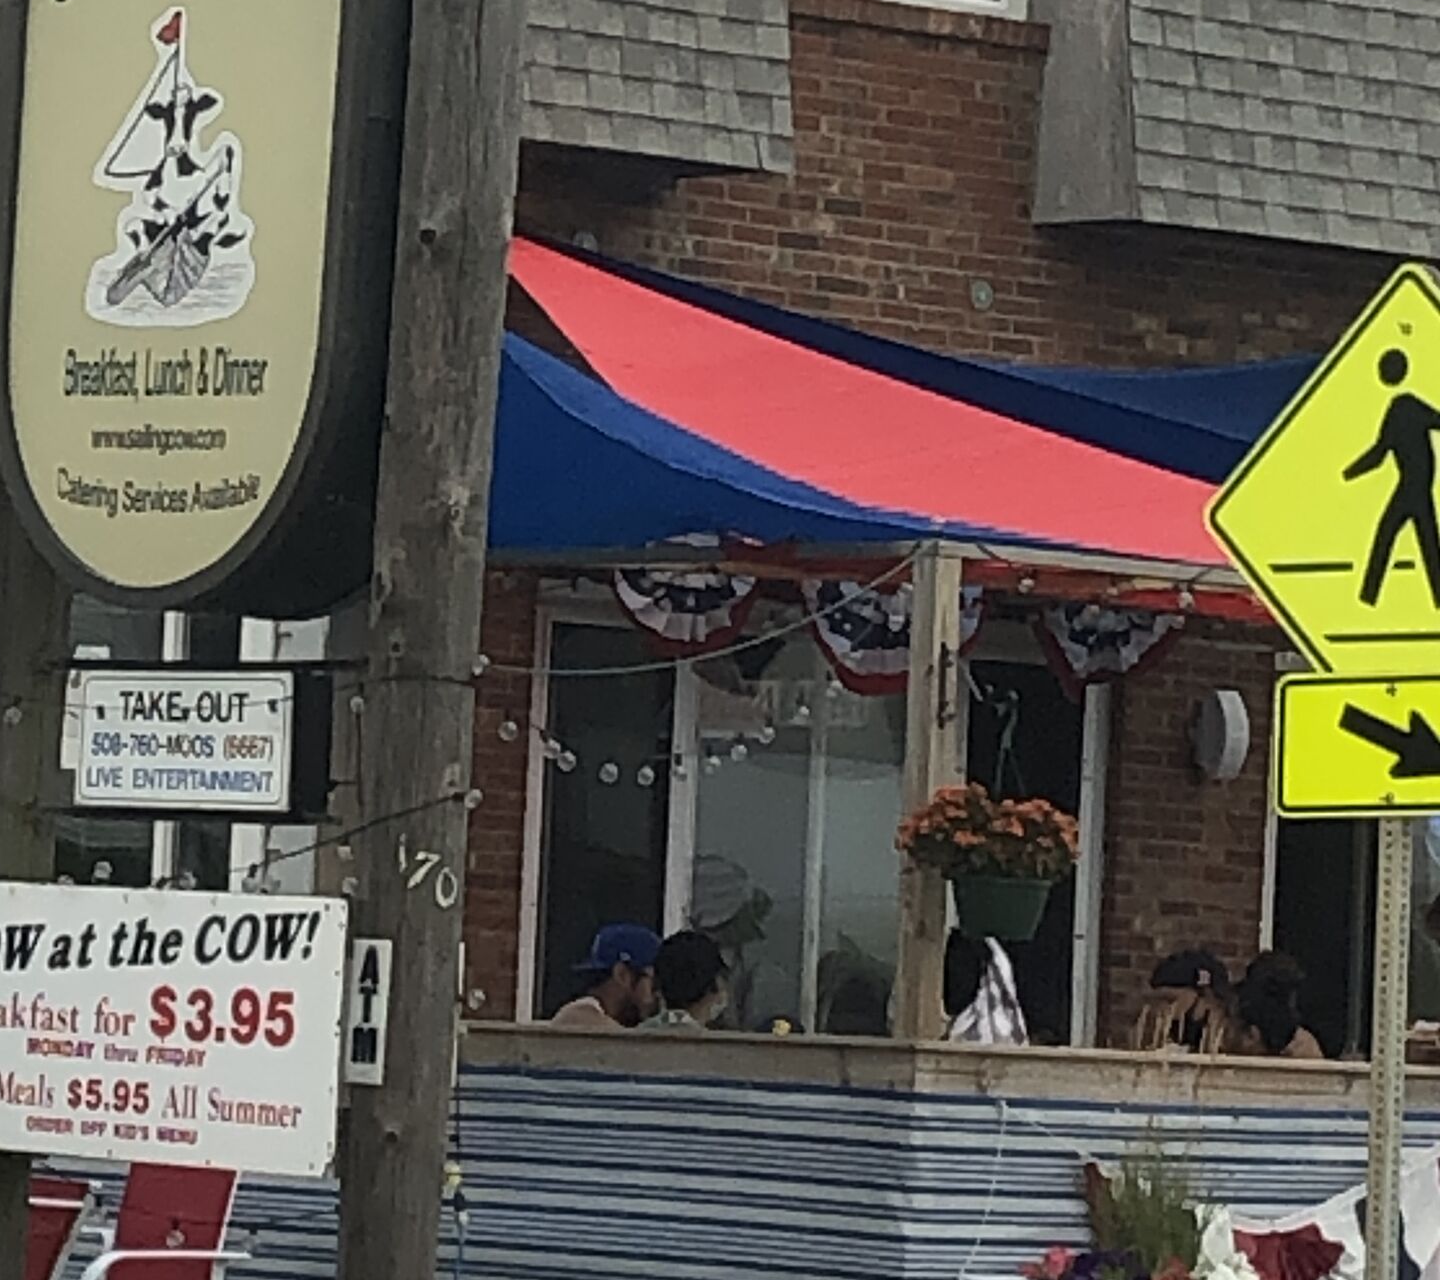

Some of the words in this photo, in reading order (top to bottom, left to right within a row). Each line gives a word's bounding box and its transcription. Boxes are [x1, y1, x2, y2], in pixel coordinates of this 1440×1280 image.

[63, 347, 139, 402] Breakfast,
[144, 347, 192, 396] Lunch
[197, 346, 209, 395] &
[213, 346, 268, 395] Dinner
[57, 467, 118, 518] Catering
[122, 480, 188, 514] Services
[190, 473, 261, 513] Available
[119, 690, 182, 722] TAKE
[197, 691, 250, 723] OUT
[86, 766, 123, 788] LIVE
[133, 768, 274, 793] ENTERTAINMENT
[398, 832, 458, 910] 170
[48, 923, 97, 969] at
[109, 917, 183, 967] the
[194, 911, 320, 965] COW!
[94, 996, 136, 1036] for
[149, 984, 295, 1048] $3.95
[350, 944, 380, 1064] ATM
[26, 1038, 94, 1060] MONDAY
[103, 1043, 138, 1062] thru
[145, 1045, 207, 1068] FRIDAY
[66, 1078, 150, 1116] $5.95
[161, 1084, 198, 1120] All
[207, 1090, 302, 1129] Summer
[25, 1115, 74, 1134] ORDER
[113, 1122, 150, 1141] KID'S
[155, 1126, 198, 1145] MENU
